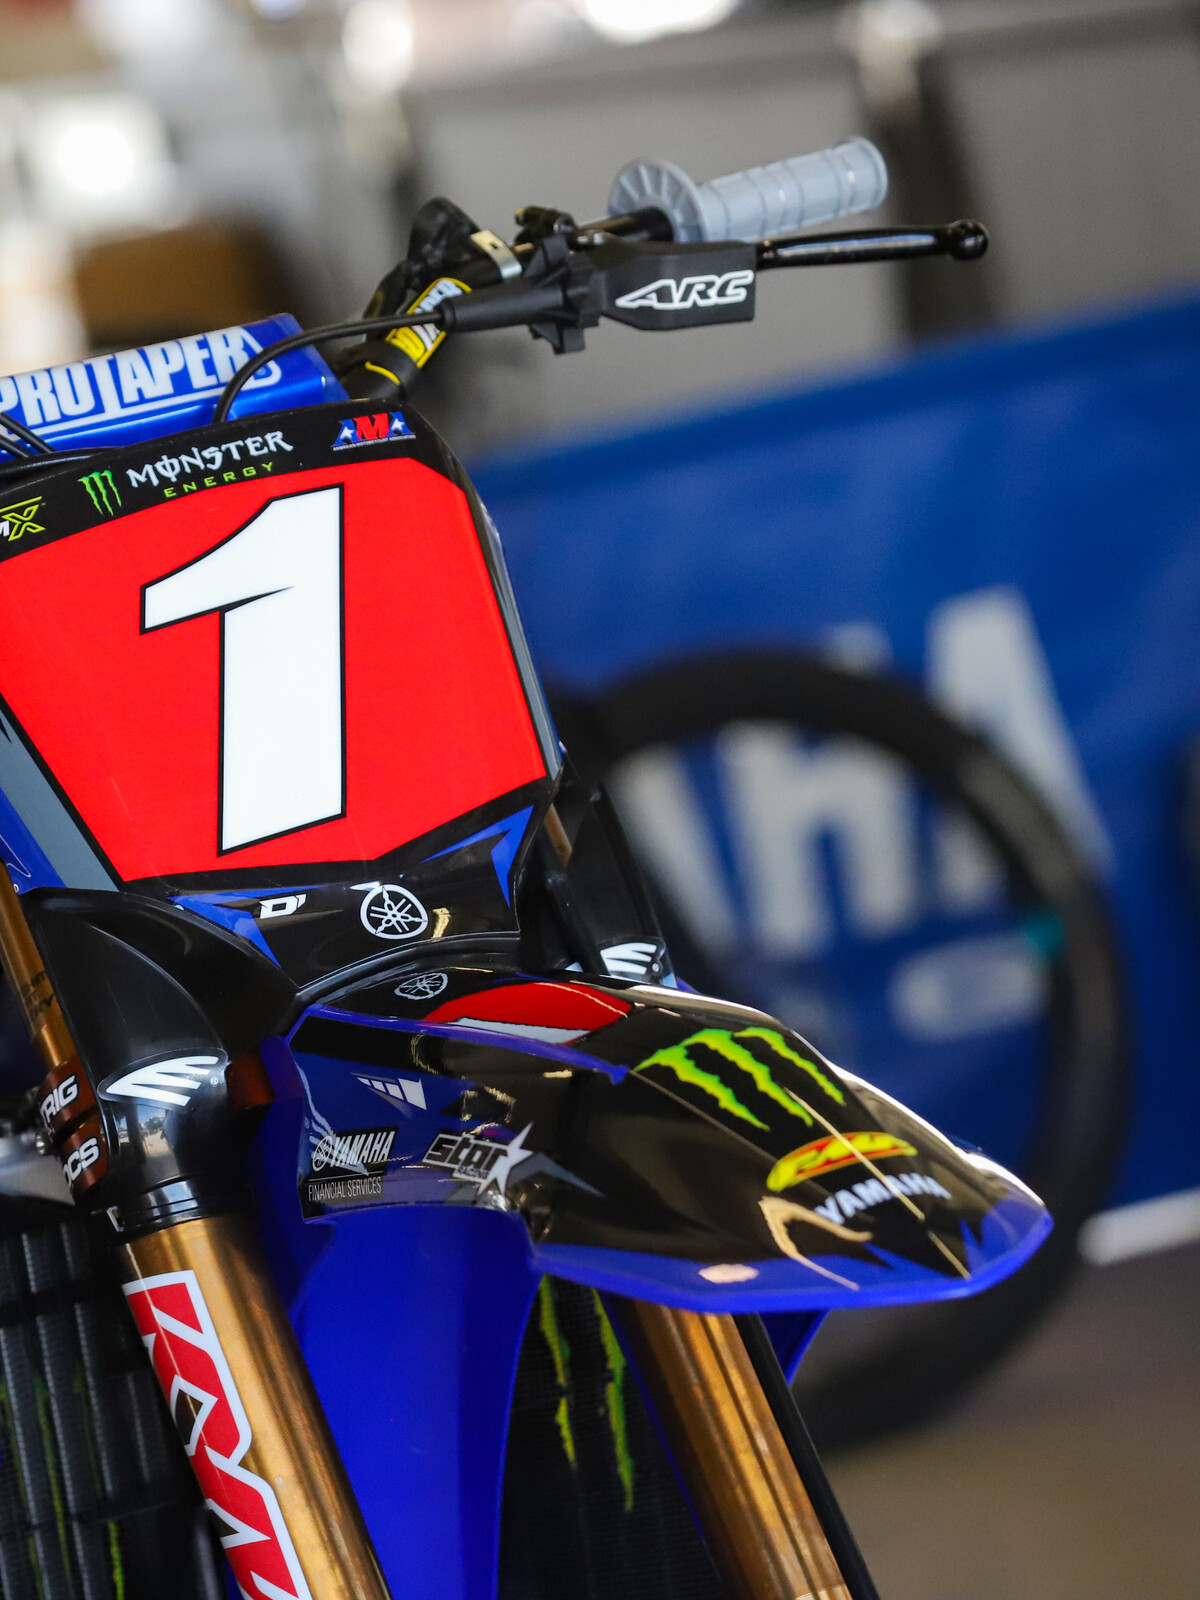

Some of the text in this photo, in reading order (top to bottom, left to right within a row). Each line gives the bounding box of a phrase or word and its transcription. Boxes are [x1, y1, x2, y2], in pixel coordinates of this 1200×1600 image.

[615, 269, 755, 311] ARC
[331, 410, 415, 448] AMA
[125, 430, 294, 489] MONSTER
[163, 461, 274, 499] ENERGY
[140, 483, 347, 858] 1
[329, 1131, 396, 1168] YAMAHA
[308, 1175, 383, 1202] FINANCIAL SERVICES
[814, 1172, 952, 1225] YAMAHA
